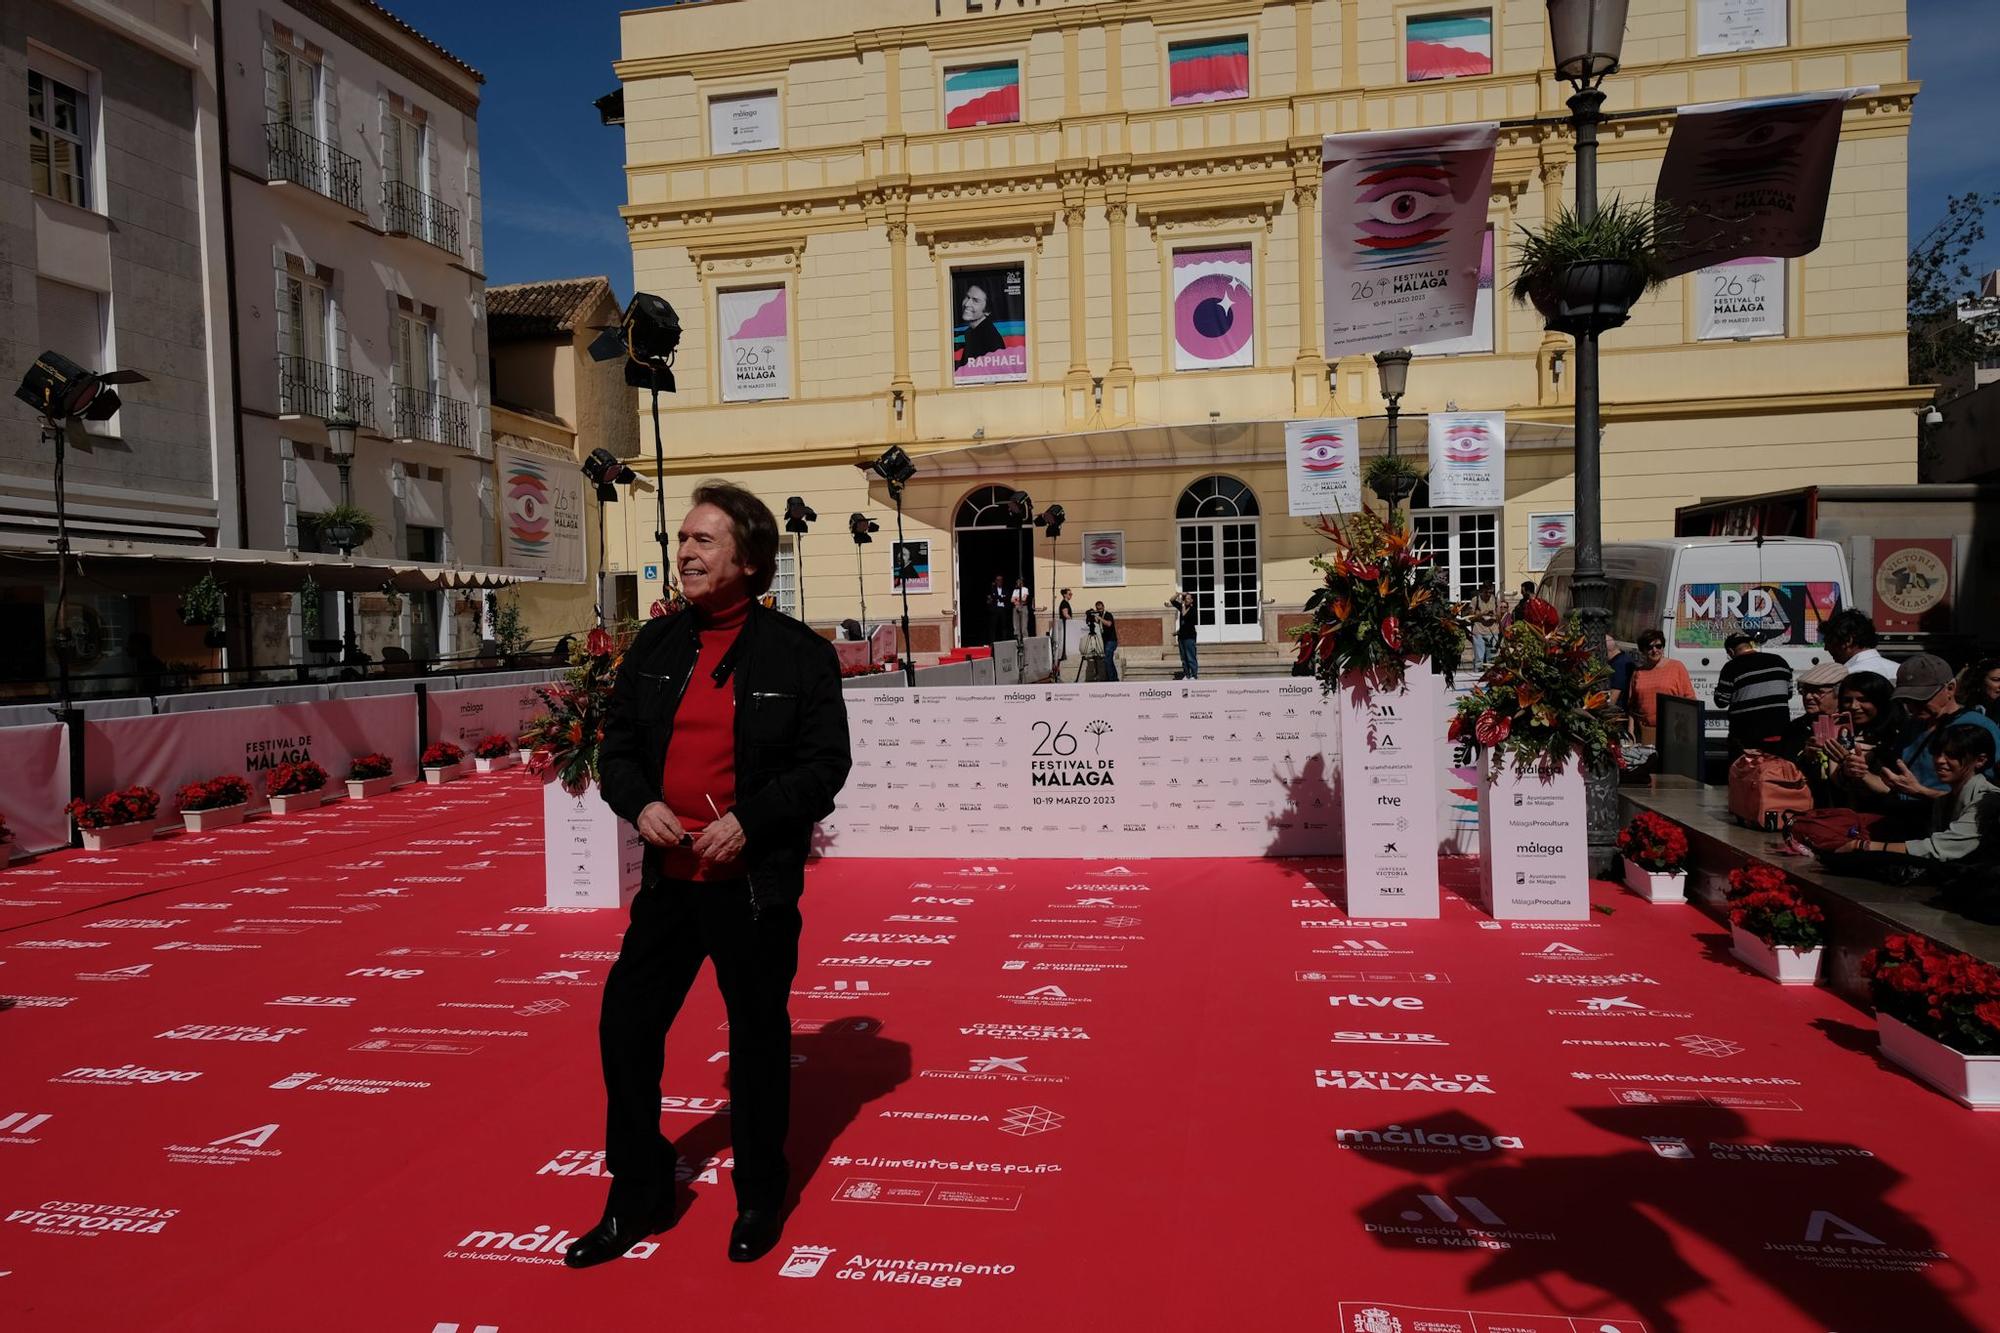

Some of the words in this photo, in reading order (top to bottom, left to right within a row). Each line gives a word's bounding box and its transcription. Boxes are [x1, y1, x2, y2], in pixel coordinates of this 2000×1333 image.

[1351, 280, 1374, 300] 26
[1393, 271, 1434, 282] FESTIVAL
[1437, 269, 1449, 277] DE
[1714, 275, 1743, 297] 26
[1714, 297, 1752, 305] FESTIVAL
[736, 347, 758, 365] 26
[967, 354, 1025, 368] RAPHAEL
[553, 487, 568, 510] 26
[1887, 554, 1936, 572] VICTORIA
[1139, 689, 1172, 699] málaga
[1279, 684, 1313, 695] málaga
[874, 694, 904, 703] málaga
[1004, 692, 1036, 701] málaga
[246, 737, 295, 753] FESTIVAL
[299, 736, 311, 746] DE
[1032, 721, 1077, 756] 26
[1032, 760, 1092, 770] FESTIVAL
[1098, 759, 1114, 769] DE
[1033, 797, 1054, 805] 10-19
[1056, 796, 1091, 804] MARZO
[1093, 796, 1116, 804] 2023
[1377, 795, 1401, 807] rtve
[1516, 842, 1563, 855] málaga
[911, 896, 975, 905] rtve
[1300, 919, 1408, 928] málaga
[821, 956, 933, 966] málaga
[346, 966, 424, 979] rtve
[276, 996, 357, 1004] SUR
[1329, 994, 1425, 1011] rtve
[176, 1024, 270, 1033] FESTIVAL
[958, 1028, 1092, 1040] VICTORIA
[972, 1023, 1083, 1033] CERVEZAS
[1333, 1031, 1442, 1042] SUR
[1562, 1039, 1671, 1047] ATRESMEDIA
[62, 1064, 203, 1084] málaga
[919, 1070, 997, 1081] Fundación
[1314, 1069, 1445, 1082] FESTIVAL
[1454, 1074, 1491, 1082] DE
[322, 1077, 431, 1089] Ayuntamiento
[330, 1084, 389, 1095] Málaga
[661, 1097, 731, 1110] SU
[879, 1110, 990, 1122] ATRESMEDIA
[1335, 1125, 1525, 1151] málaga
[1353, 1144, 1400, 1152] ciudad
[1403, 1146, 1462, 1155] redonda
[1709, 1142, 1875, 1158] Ayuntamiento
[828, 1155, 1063, 1174] #alimentosdespaña
[1712, 1152, 1736, 1161] de
[1751, 1152, 1840, 1166] Málaga
[40, 1200, 181, 1219] CERVEZAS
[4, 1210, 168, 1233] VICTORIA
[1365, 1223, 1462, 1237] Diputación
[1467, 1228, 1556, 1241] Provincial
[457, 1225, 661, 1260] málaa
[1415, 1236, 1439, 1245] de
[1444, 1237, 1512, 1251] Málaga
[1763, 1242, 1817, 1252] Junta
[1822, 1245, 1847, 1255] de
[444, 1251, 458, 1259] la
[461, 1251, 511, 1262] ciudad
[846, 1254, 1016, 1275] Ayuntamiento
[835, 1268, 866, 1281] de
[872, 1269, 963, 1289] Málaga
[1413, 1320, 1461, 1329] GOBIERNO
